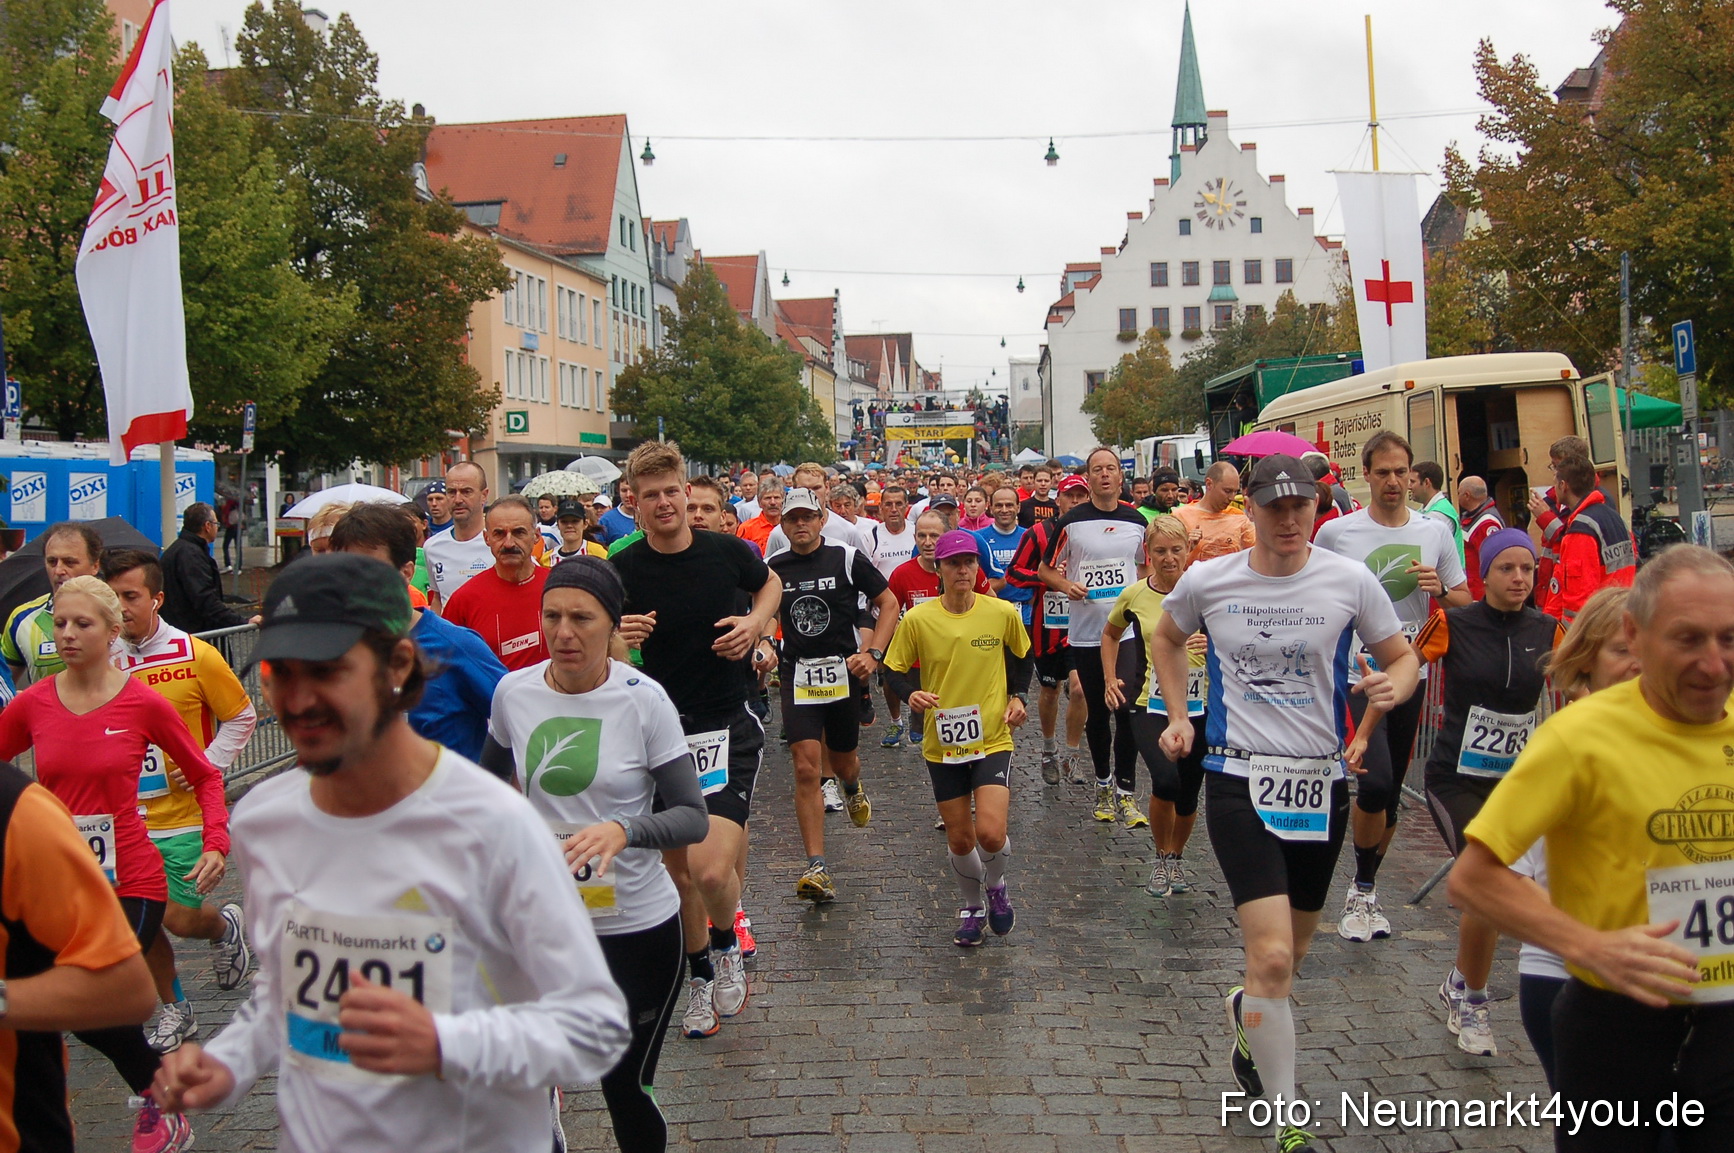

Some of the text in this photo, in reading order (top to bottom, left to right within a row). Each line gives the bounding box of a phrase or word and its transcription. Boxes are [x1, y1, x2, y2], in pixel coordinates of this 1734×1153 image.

[1676, 329, 1690, 368] P
[508, 413, 526, 431] D
[1334, 411, 1382, 438] Bayerisches
[914, 429, 945, 437] START
[1334, 441, 1357, 459] Rotes
[1034, 506, 1054, 518] RUN
[1085, 569, 1124, 588] 2335
[1227, 604, 1304, 616] 12. Hilpoltsteiner
[1247, 617, 1325, 629] Burgfestlauf 2012
[511, 638, 529, 649] DEHN
[148, 668, 197, 685] BÖGL
[805, 666, 837, 686] 115
[807, 688, 835, 697] Michael
[1470, 713, 1496, 725] PARTL
[941, 719, 980, 744] 520
[1471, 725, 1529, 755] 2263
[956, 747, 969, 755] Ute
[1251, 763, 1321, 776] PARTL Neumarkt
[1258, 776, 1324, 809] 2468
[1270, 815, 1310, 829] Andreas
[1650, 879, 1701, 894] PARTL
[1683, 894, 1734, 948] 48
[286, 919, 417, 951] PARTL Neumarkt
